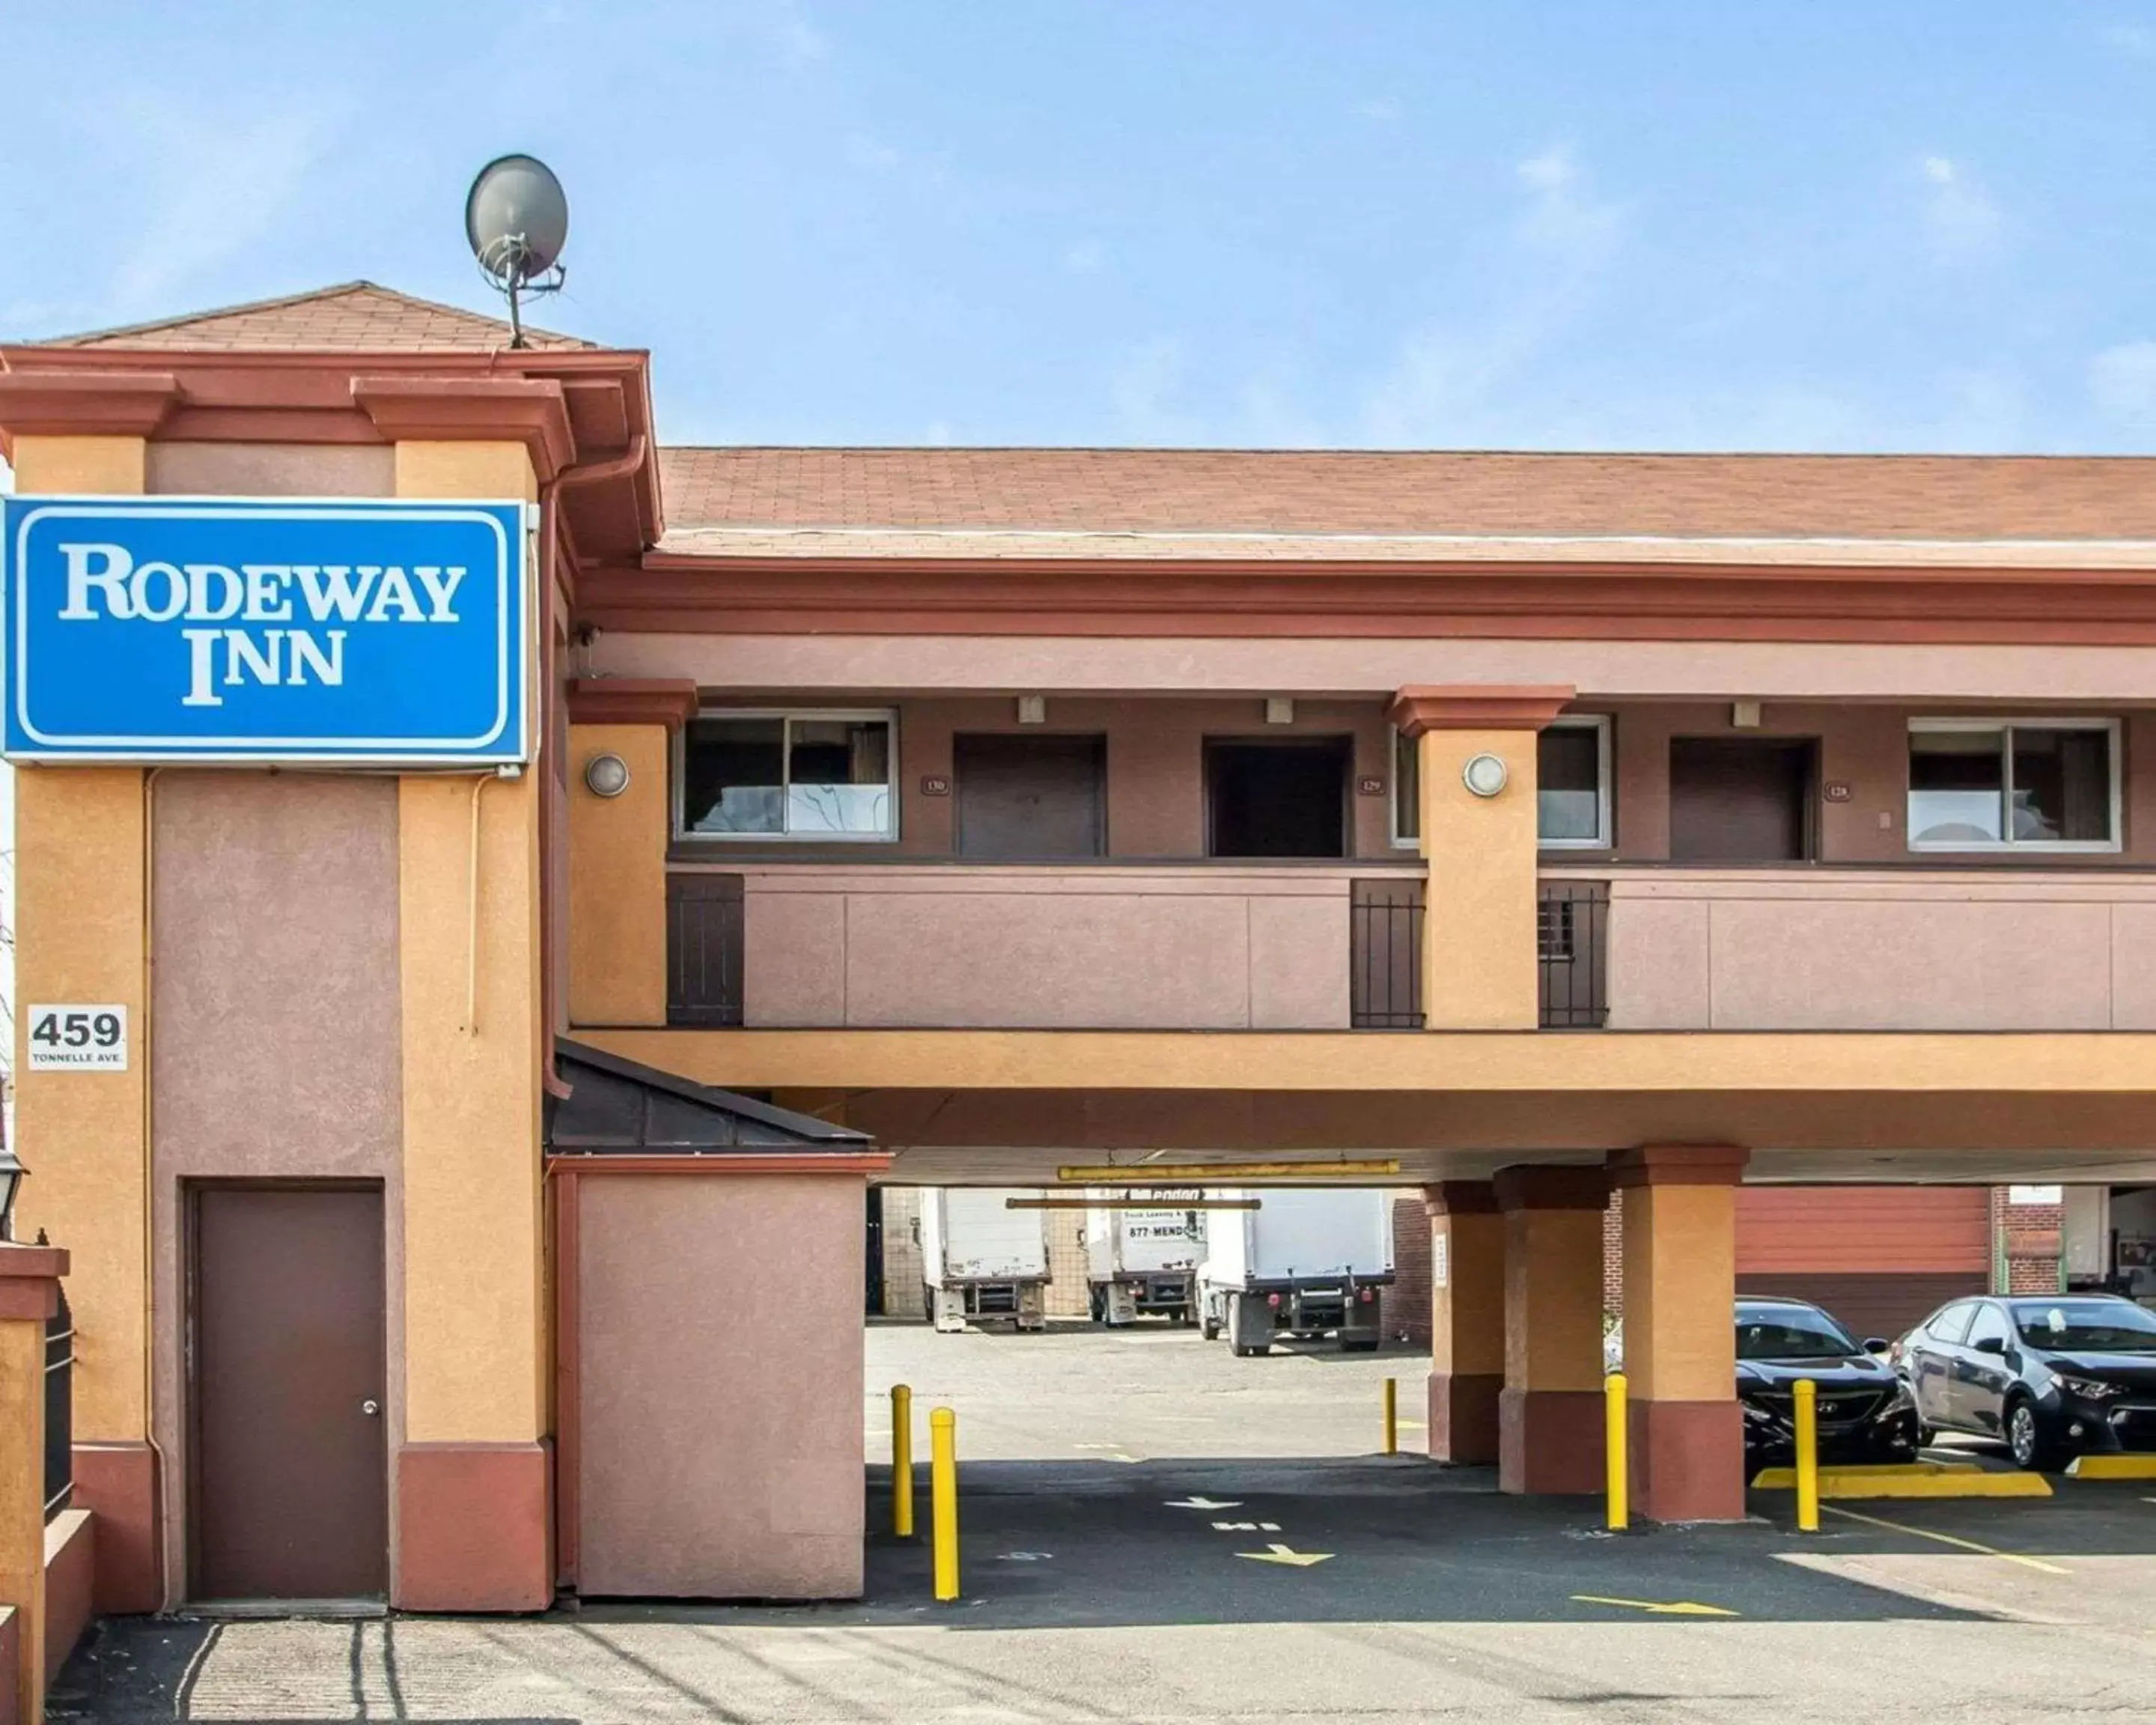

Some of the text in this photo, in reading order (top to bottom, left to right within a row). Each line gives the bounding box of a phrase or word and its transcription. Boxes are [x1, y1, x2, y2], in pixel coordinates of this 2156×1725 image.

[58, 543, 466, 623] RODEWAY
[182, 629, 347, 706] INN
[33, 1013, 121, 1047] 459
[33, 1053, 92, 1062] TONNELLE
